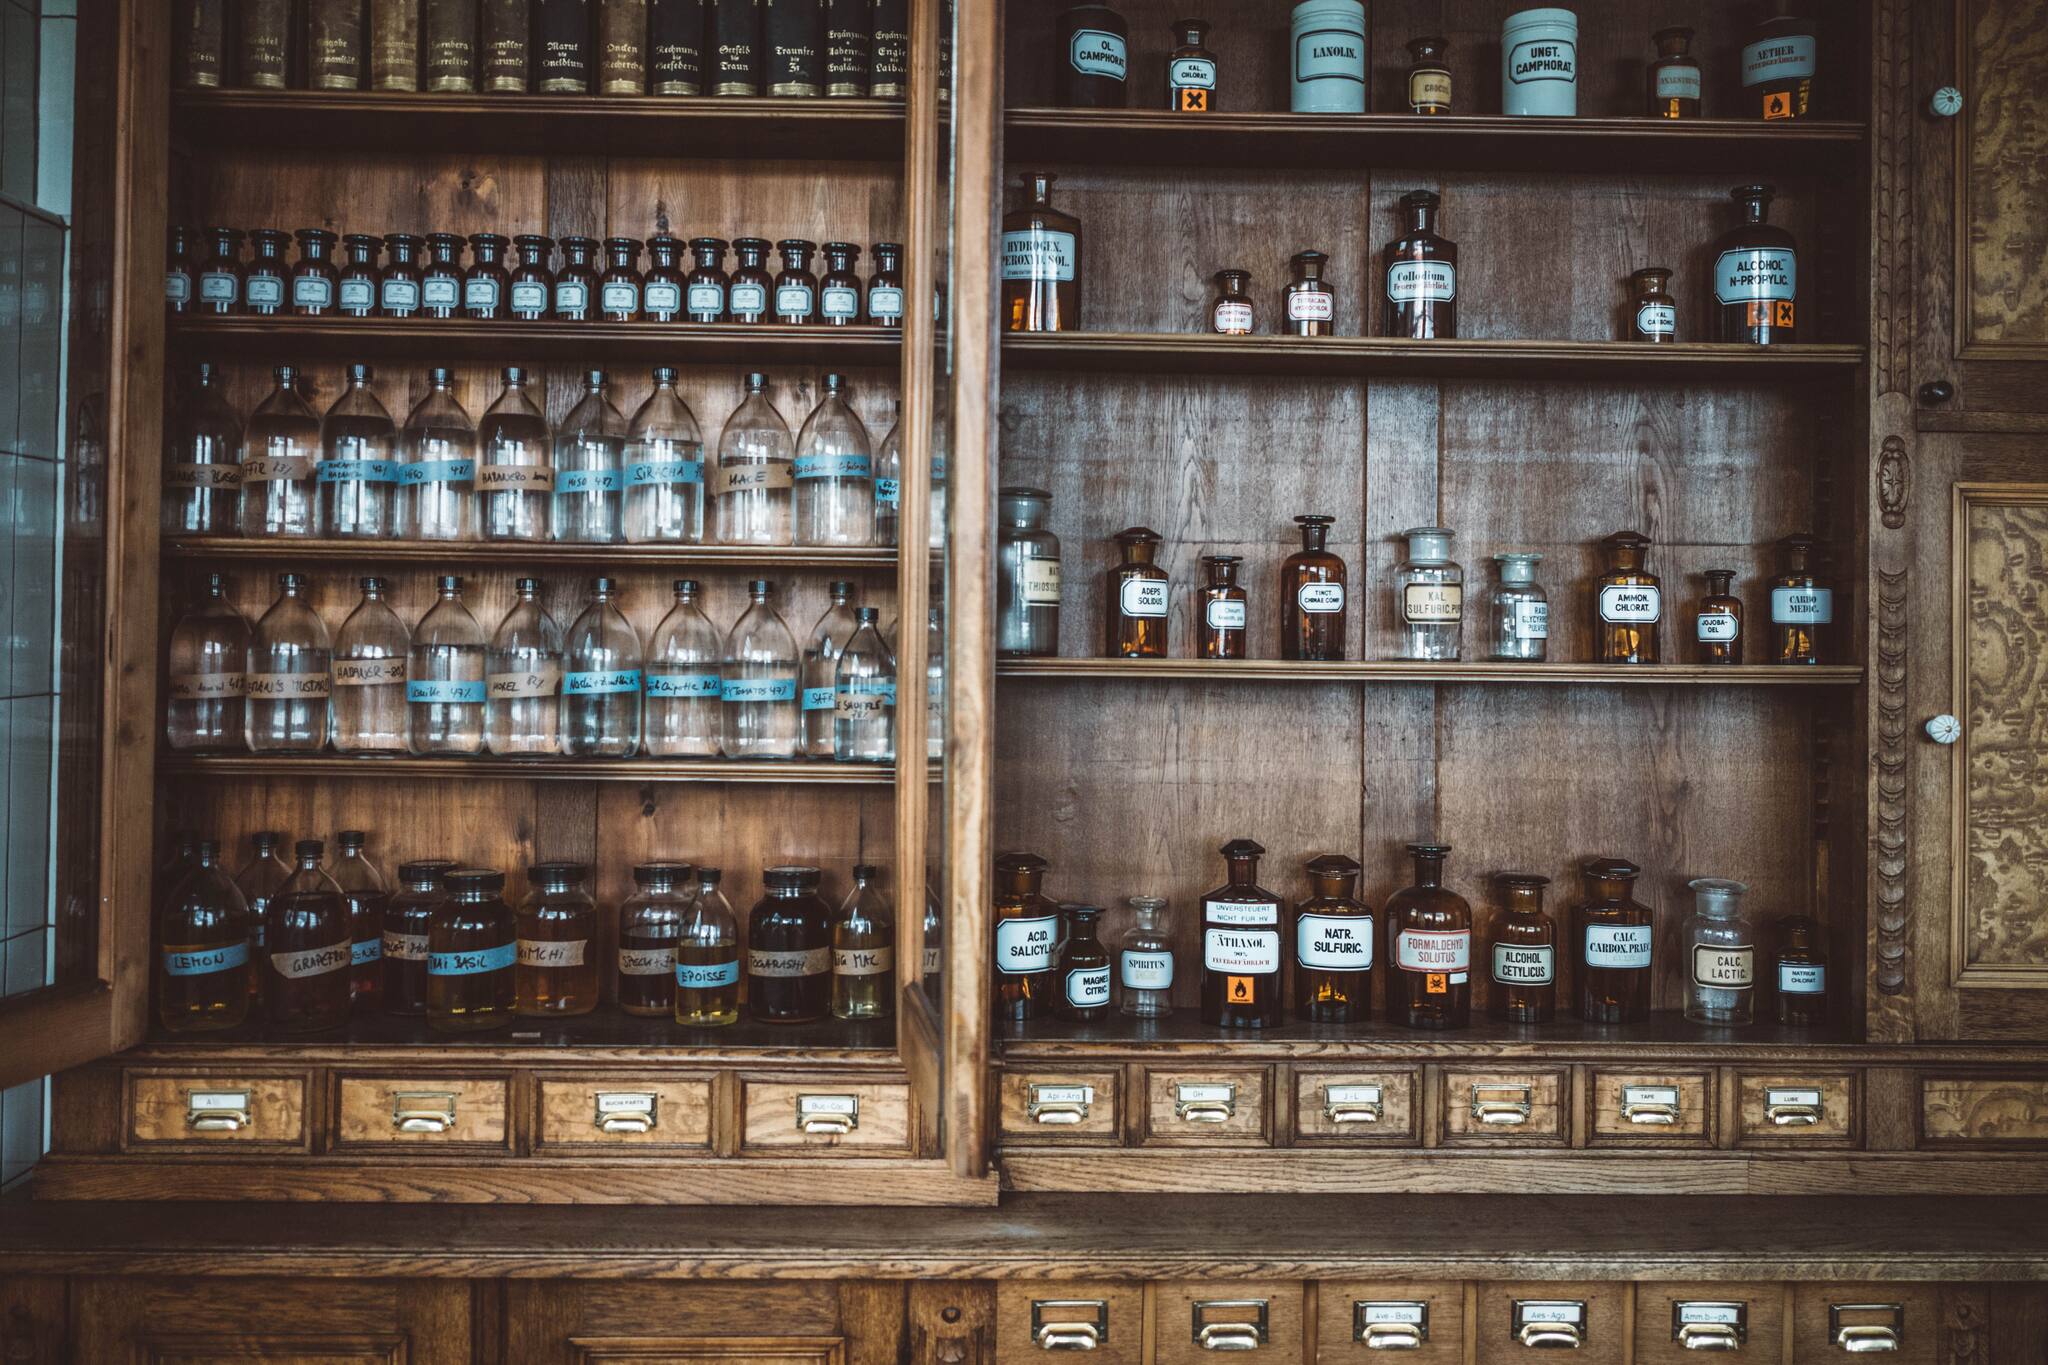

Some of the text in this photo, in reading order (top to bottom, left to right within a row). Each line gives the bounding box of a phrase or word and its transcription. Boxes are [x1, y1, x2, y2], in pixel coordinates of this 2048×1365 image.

[1101, 40, 1114, 51] OL.
[1531, 46, 1560, 59] UNGT.
[1516, 60, 1573, 75] CAMPHORAT.
[1737, 258, 1783, 272] ALCOHOL
[1397, 270, 1445, 281] Collodium
[1141, 587, 1161, 596] ADEPS
[1138, 596, 1163, 606] SOLIDUS
[1617, 594, 1649, 602] AMMON.
[1615, 603, 1650, 612] CHLORAT.
[1701, 619, 1728, 627] JOJOBA-
[1027, 930, 1049, 943] ACID.
[1324, 927, 1354, 940] NATR.
[1613, 932, 1637, 942] CALC.
[1314, 941, 1363, 954] SULFURIC.
[174, 952, 225, 969] LEMON
[1418, 951, 1456, 964] SOLUTUS
[1505, 952, 1542, 964] ALCOHOL
[1717, 956, 1743, 967] CALC.
[1128, 959, 1165, 970] SPIRITUS
[1502, 966, 1545, 978] CETYLICUS
